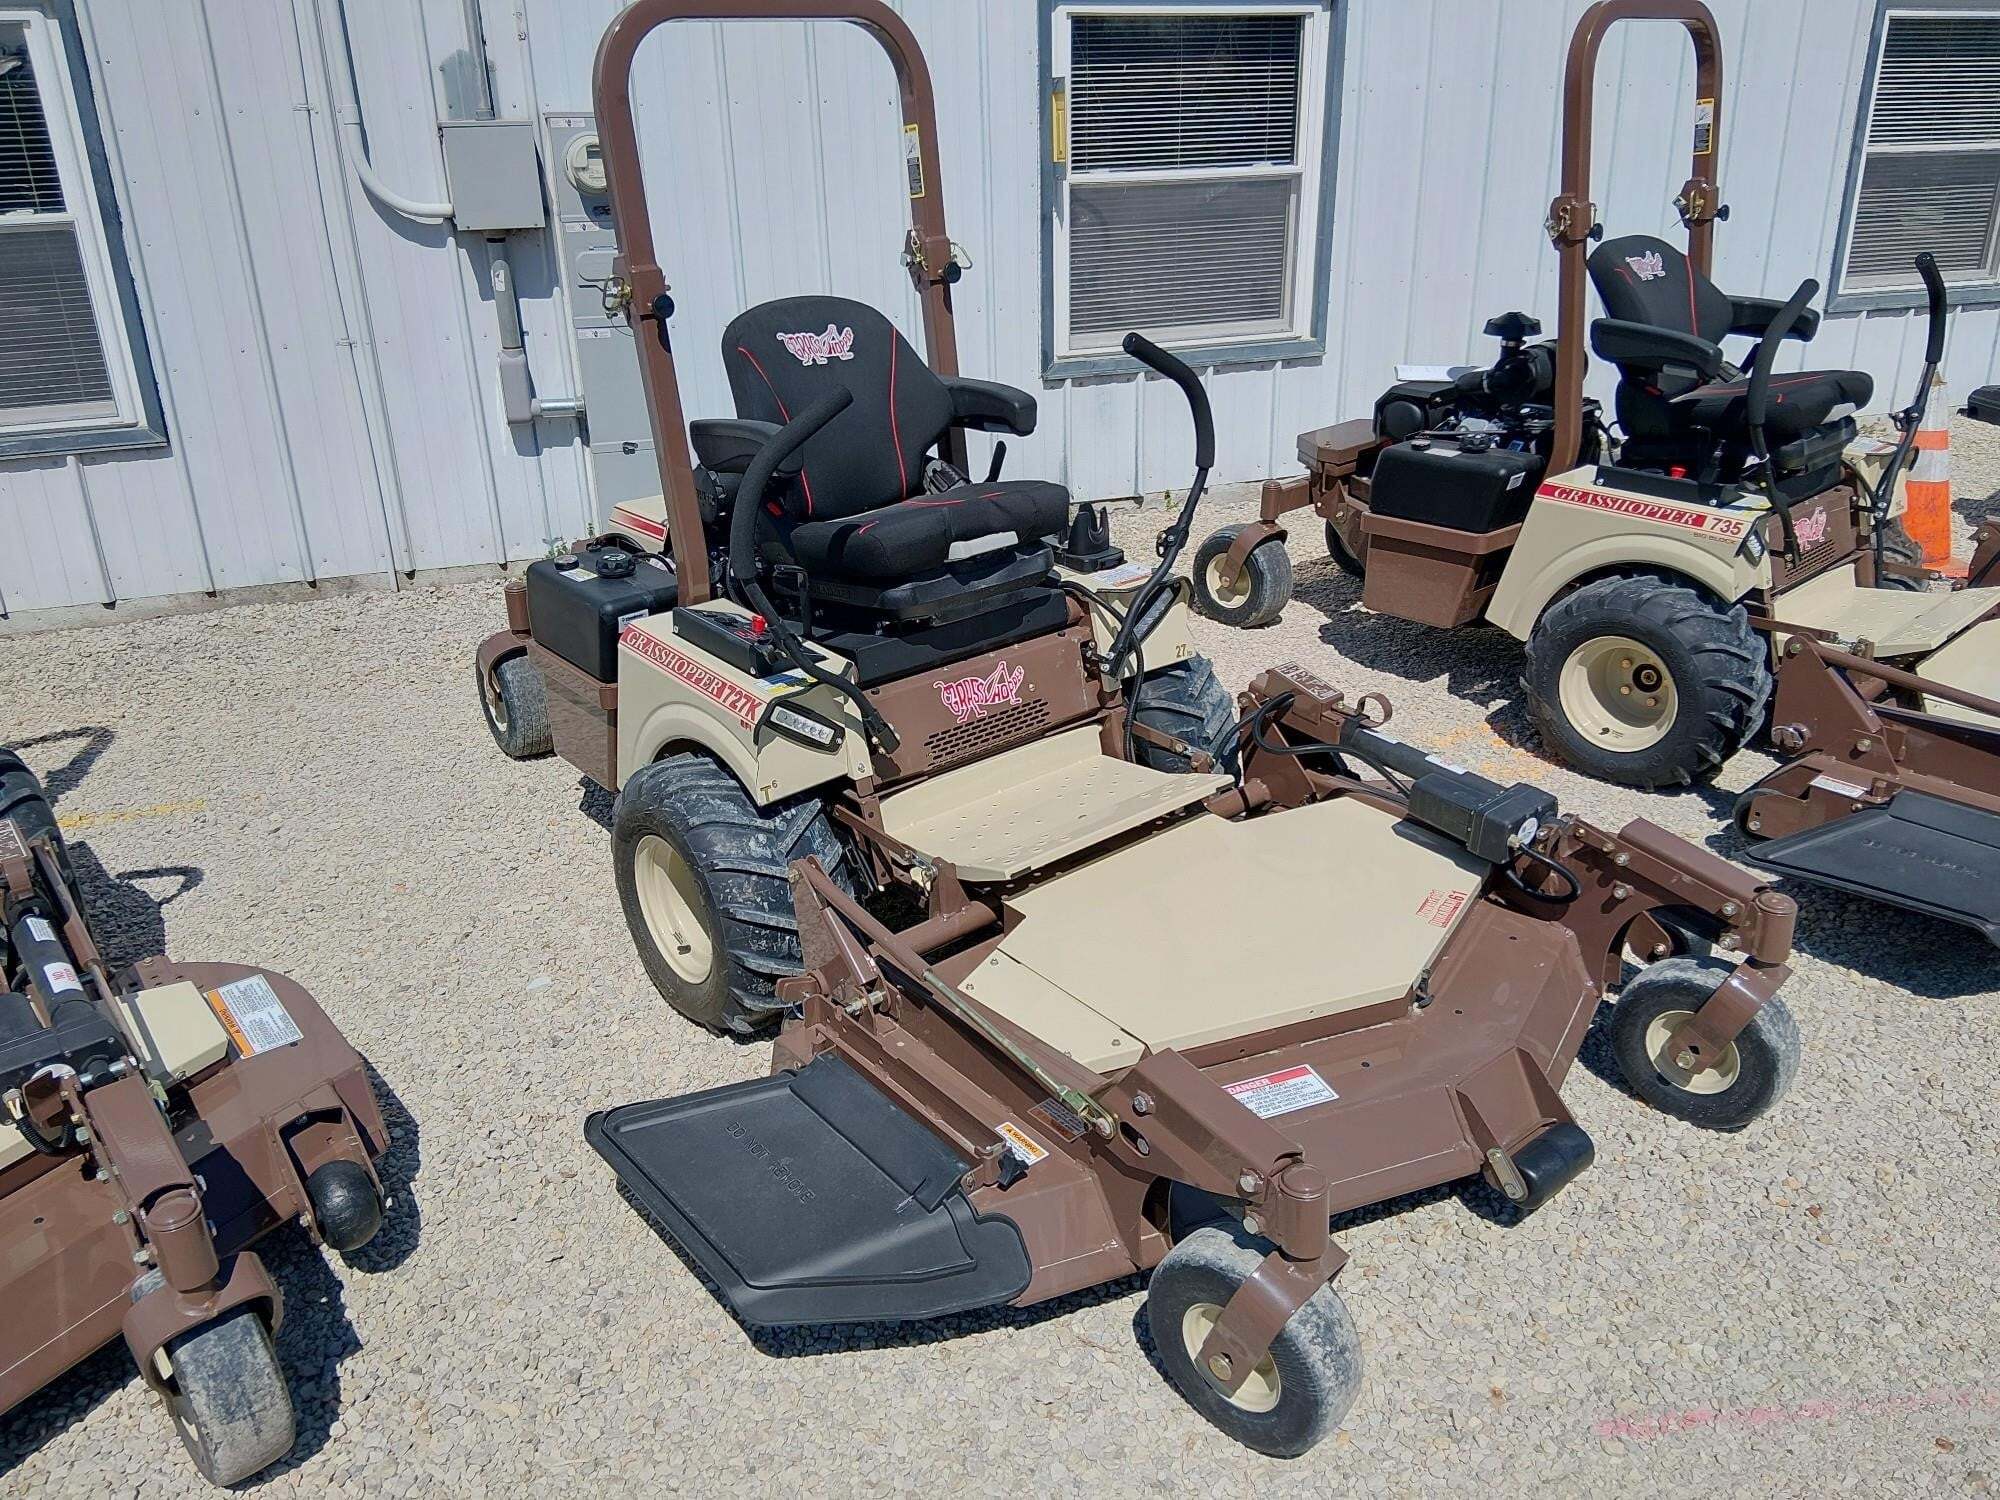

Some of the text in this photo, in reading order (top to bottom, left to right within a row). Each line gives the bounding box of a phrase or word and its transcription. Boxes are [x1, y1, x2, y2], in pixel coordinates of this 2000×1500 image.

[1554, 486, 1744, 536] GRASSHOPPER 735
[1175, 643, 1187, 658] 27
[627, 631, 722, 696] GRASSHOPPER
[721, 684, 763, 722] 727K
[1228, 1078, 1270, 1095] DANGER
[725, 1121, 816, 1204] DO NOT REMOVE
